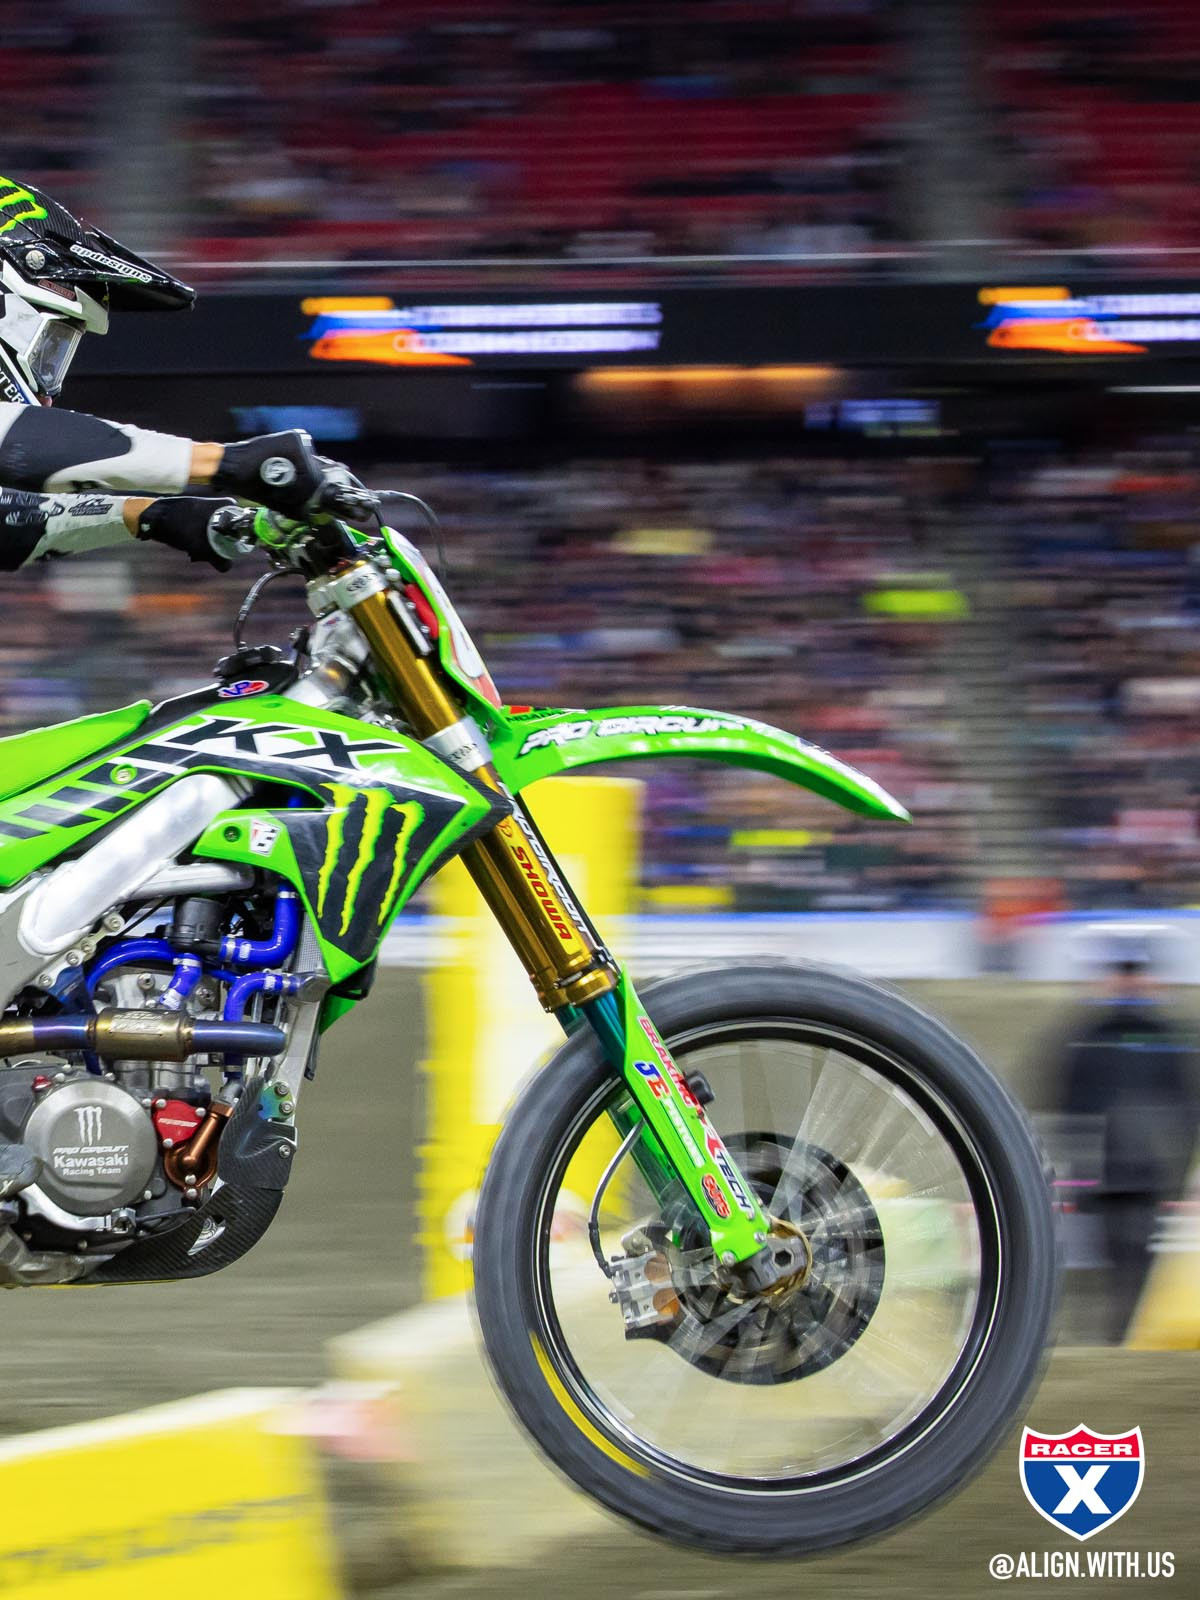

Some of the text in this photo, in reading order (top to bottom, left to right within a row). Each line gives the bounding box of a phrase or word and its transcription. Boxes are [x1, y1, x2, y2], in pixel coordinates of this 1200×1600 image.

[164, 718, 407, 770] KX
[515, 720, 594, 757] PRO
[512, 845, 573, 941] SHOWA
[634, 1062, 671, 1099] JE
[54, 1153, 129, 1169] Kawasaki
[62, 1166, 122, 1177] Racing Team
